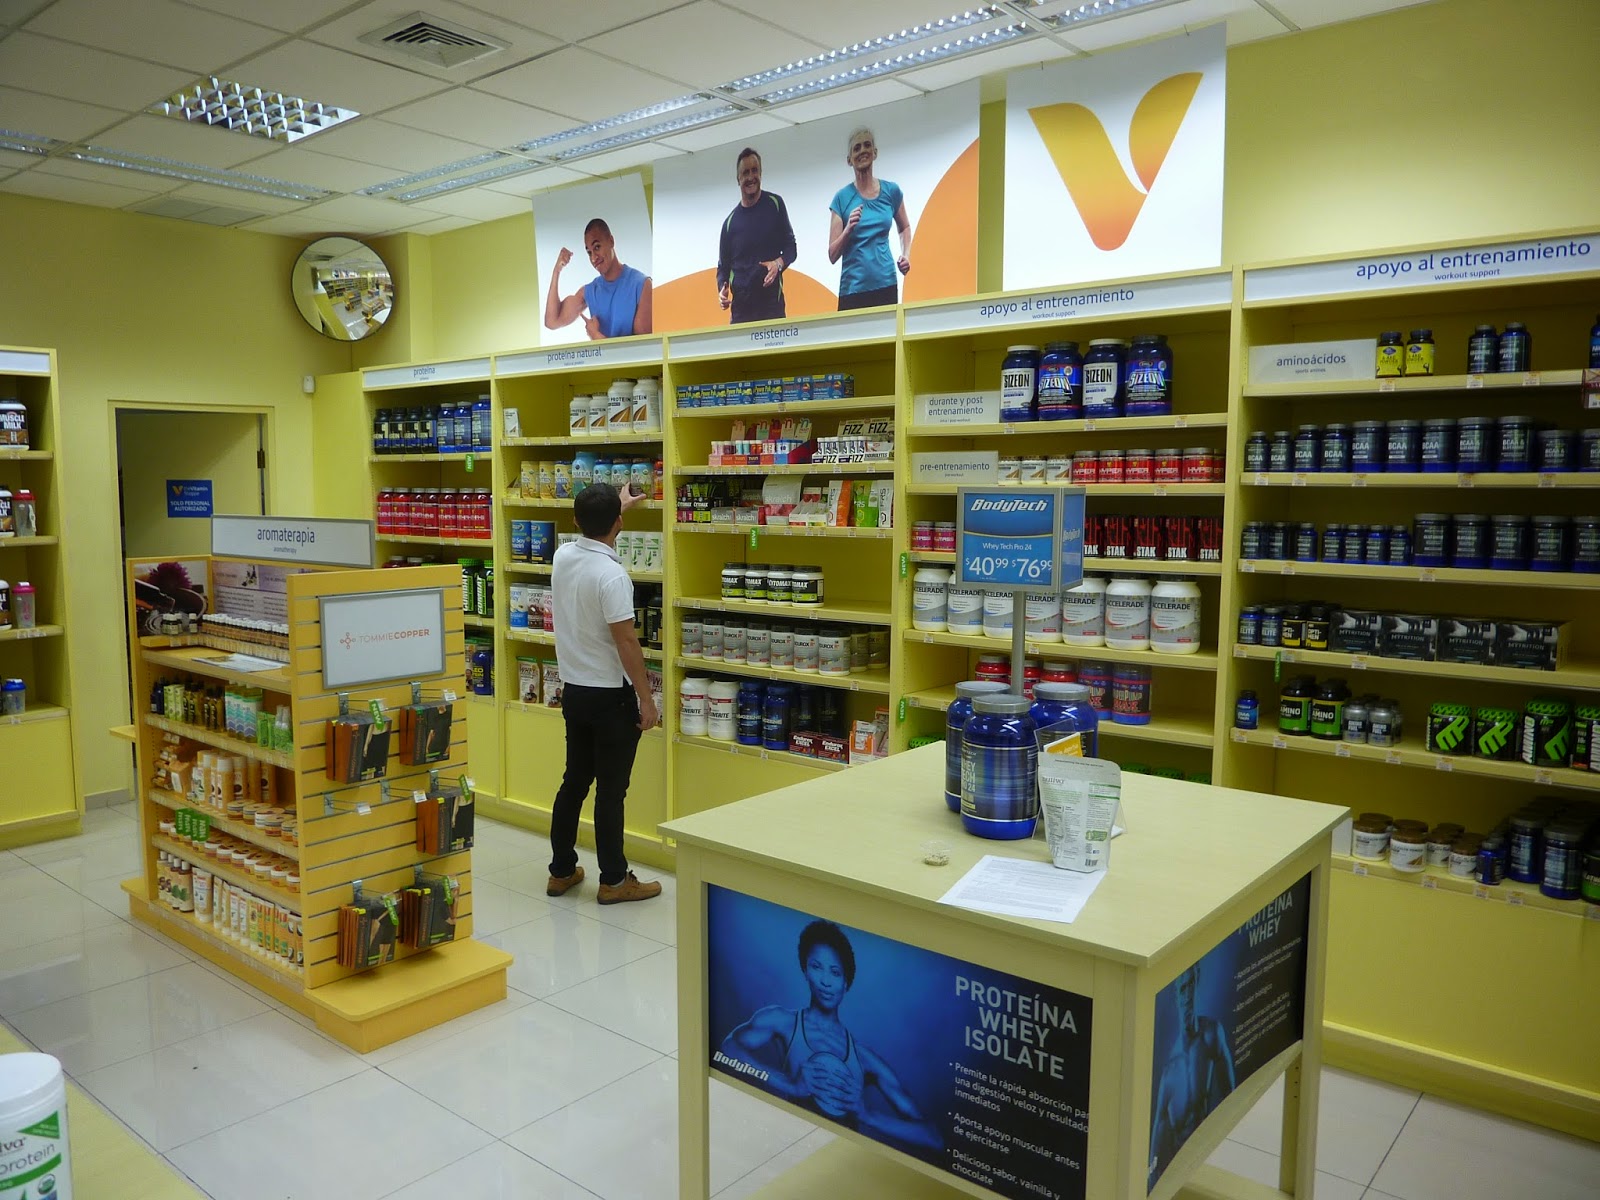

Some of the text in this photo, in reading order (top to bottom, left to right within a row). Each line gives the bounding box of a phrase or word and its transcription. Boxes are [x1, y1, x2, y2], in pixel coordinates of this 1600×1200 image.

[1356, 241, 1591, 279] apoyo al entrenamiento
[1434, 268, 1500, 281] workout support
[980, 288, 1134, 318] apoyo al entrenamiento
[1032, 310, 1076, 320] workout support
[750, 326, 799, 341] resistencia
[547, 346, 602, 364] proteína natural
[1276, 352, 1346, 367] aminoácidos
[413, 366, 436, 378] proteína
[1085, 368, 1112, 384] SIZEON
[1003, 373, 1030, 389] SIZEON
[929, 396, 983, 406] durante y post
[928, 406, 984, 416] entrenamiento
[4, 421, 22, 430] MILK
[843, 424, 864, 435] FIZZ
[868, 422, 888, 434] FIZZ
[1352, 442, 1370, 451] BCAA
[1388, 442, 1407, 450] BCAA
[1422, 441, 1439, 450] BCAA
[822, 454, 837, 464] FIZZ
[848, 454, 864, 463] FIZZ
[1295, 450, 1313, 458] BCAA
[1324, 450, 1343, 458] BCAA
[919, 462, 990, 472] pre-entrenamiento
[764, 495, 793, 503] skratch
[971, 498, 1048, 513] BodyTech
[257, 526, 315, 547] aromaterapia
[982, 542, 999, 551] Whey
[1084, 545, 1099, 555] TAK
[1106, 545, 1126, 556] STAK
[1136, 546, 1157, 557] STAK
[1167, 547, 1187, 558] STAK
[1199, 548, 1220, 560] STAK
[372, 704, 382, 724] NEW
[1280, 707, 1301, 715] AMINO
[1312, 711, 1334, 719] AMINO
[1249, 915, 1281, 948] WHEY
[954, 975, 1078, 1034] PROTEÍNA
[979, 1006, 1051, 1048] WHEY
[964, 1026, 1065, 1081] ISOLATE
[712, 1050, 770, 1081] BodyTech
[955, 1062, 988, 1082] Premite
[988, 1074, 998, 1085] la
[999, 1079, 1027, 1096] rápida
[1028, 1090, 1073, 1114] absorción
[954, 1087, 1001, 1112] inmediatos
[954, 1076, 1089, 1133] una digestión veloz y resultado
[953, 1125, 1010, 1154] de ejercitarse
[953, 1112, 1080, 1170] Aporta apoyo muscular antes
[951, 1162, 994, 1186] chocolate
[952, 1149, 991, 1172] Delicioso
[992, 1167, 1018, 1184] sabor,
[1019, 1178, 1052, 1198] vainilla
